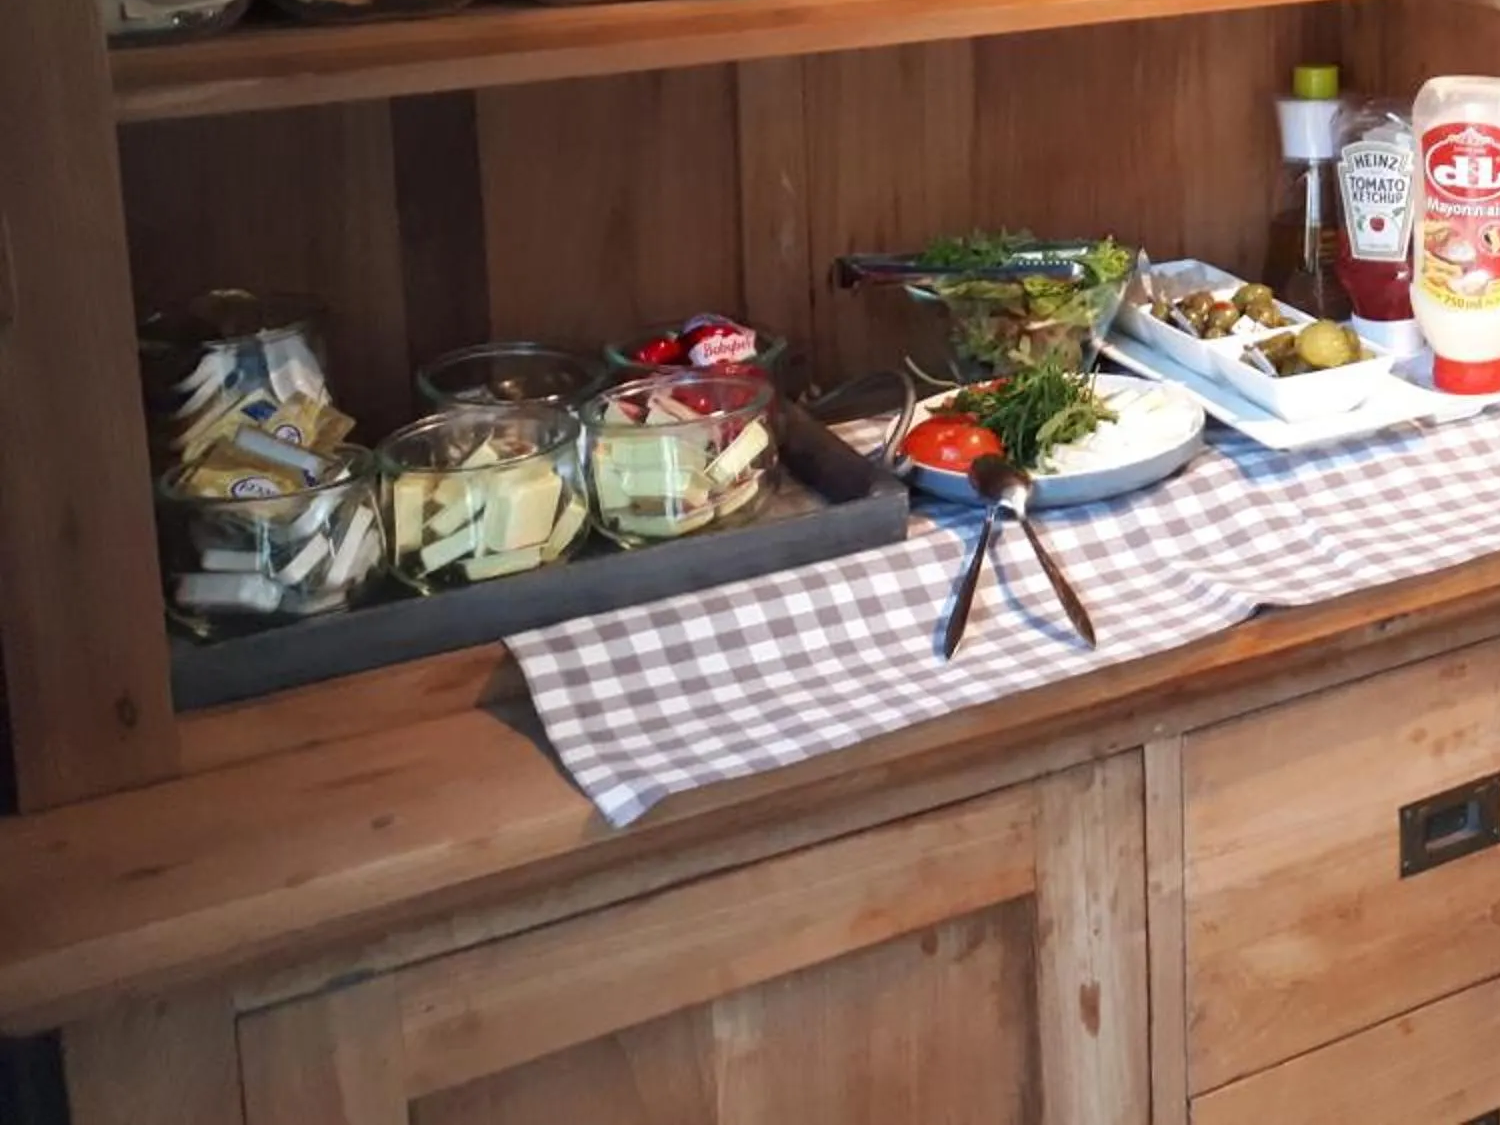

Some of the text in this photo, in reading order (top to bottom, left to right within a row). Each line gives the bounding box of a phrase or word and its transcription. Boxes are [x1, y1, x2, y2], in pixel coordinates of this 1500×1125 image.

[1354, 153, 1399, 171] HEINZ
[1350, 176, 1406, 192] TOMATO
[1353, 191, 1403, 204] KETCHUP
